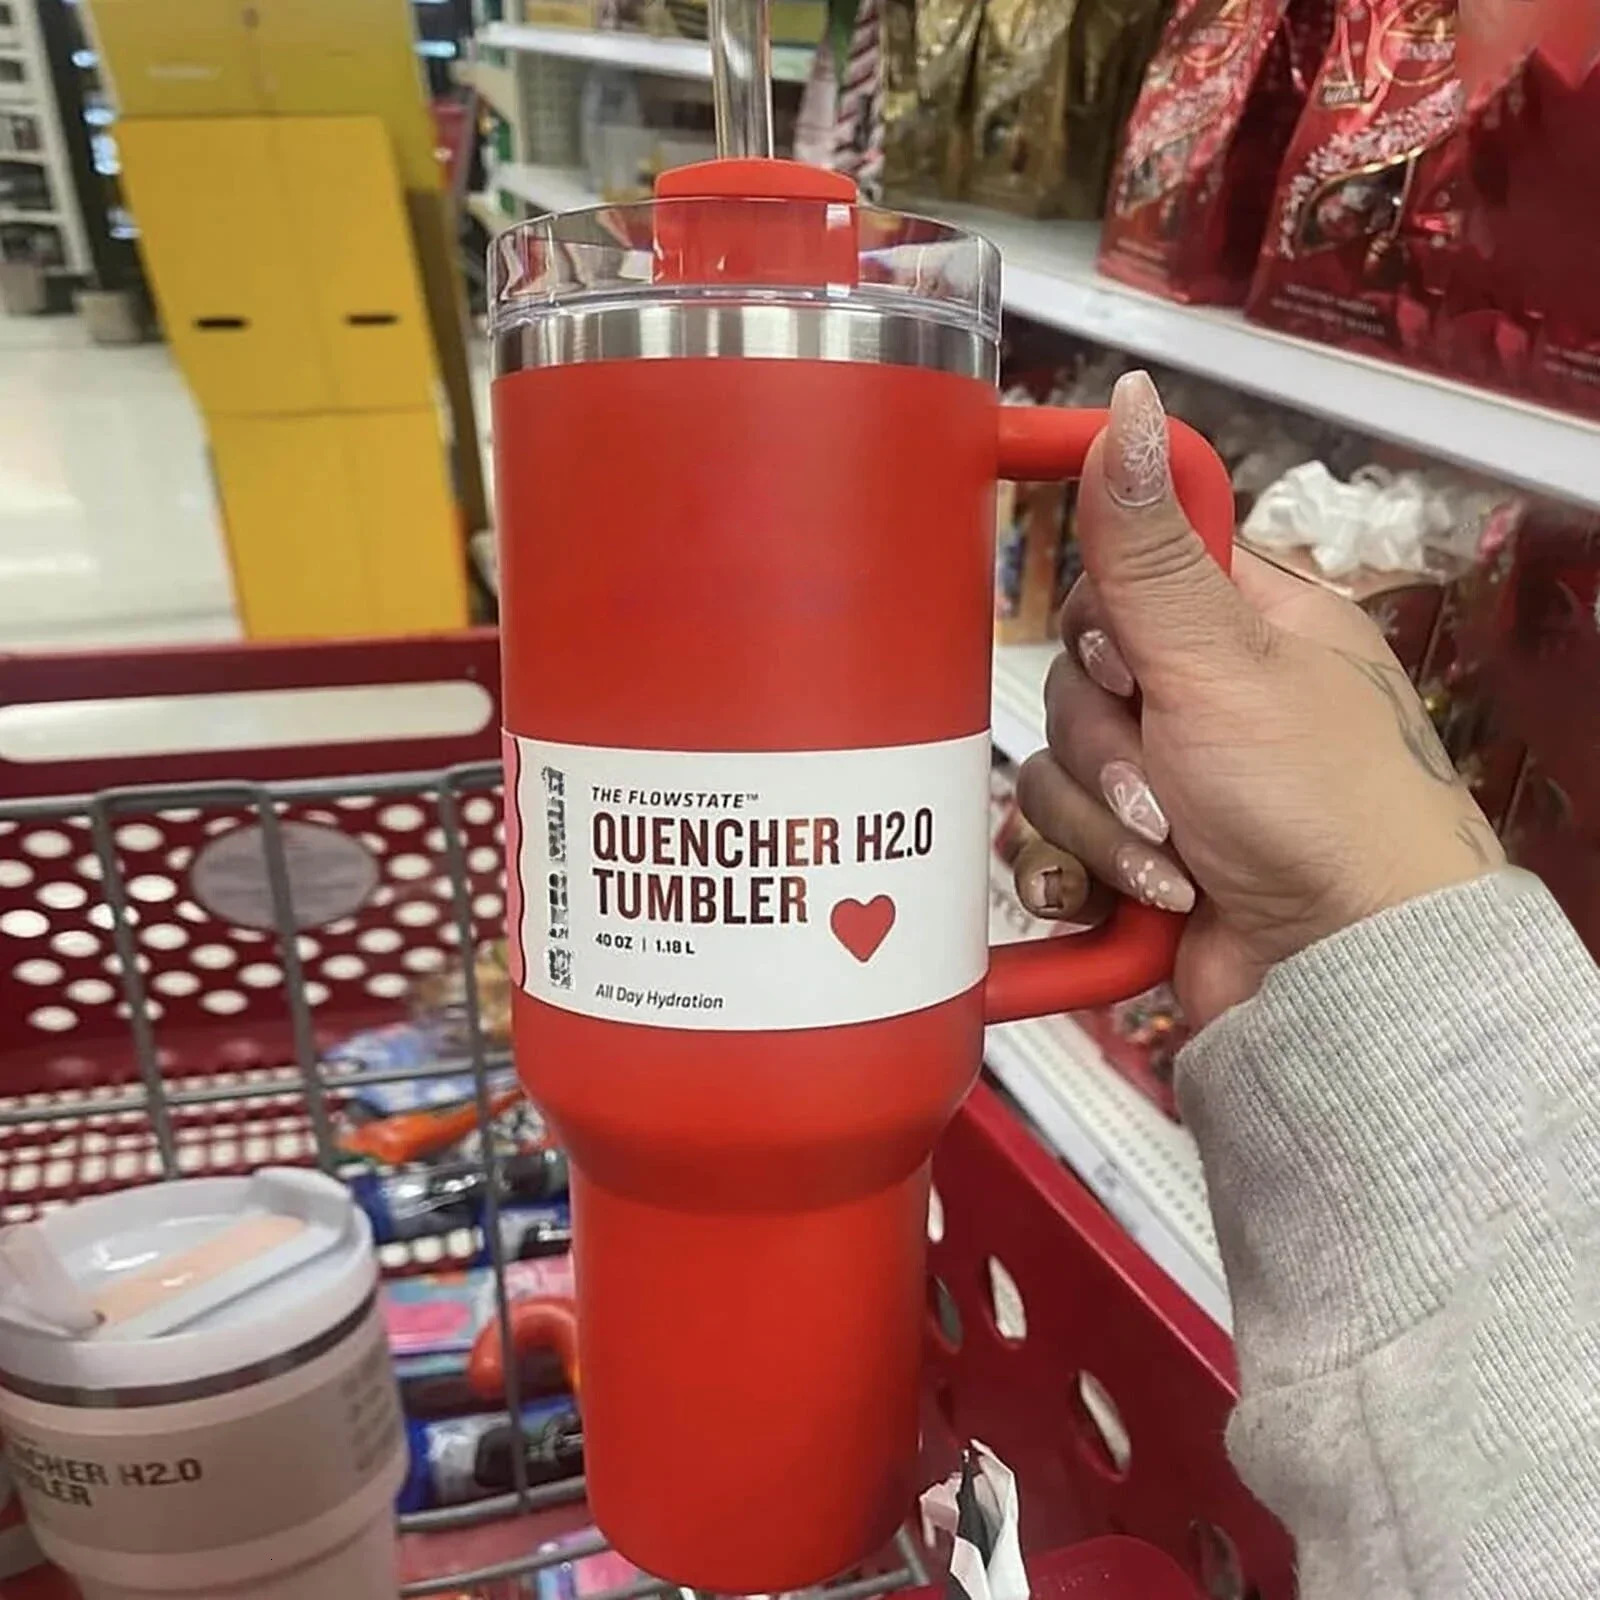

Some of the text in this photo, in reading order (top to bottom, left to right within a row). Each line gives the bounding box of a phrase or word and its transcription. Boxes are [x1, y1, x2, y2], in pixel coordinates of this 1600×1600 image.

[592, 787, 622, 803] THE
[592, 808, 934, 868] QUENCHER H2.0
[592, 868, 808, 925] TUMBLER
[595, 933, 612, 948] 40
[614, 935, 633, 950] OZ
[655, 938, 682, 954] 1.18
[685, 940, 696, 955] L
[595, 983, 724, 1009] All Day Hydration
[119, 1457, 203, 1487] H2.0
